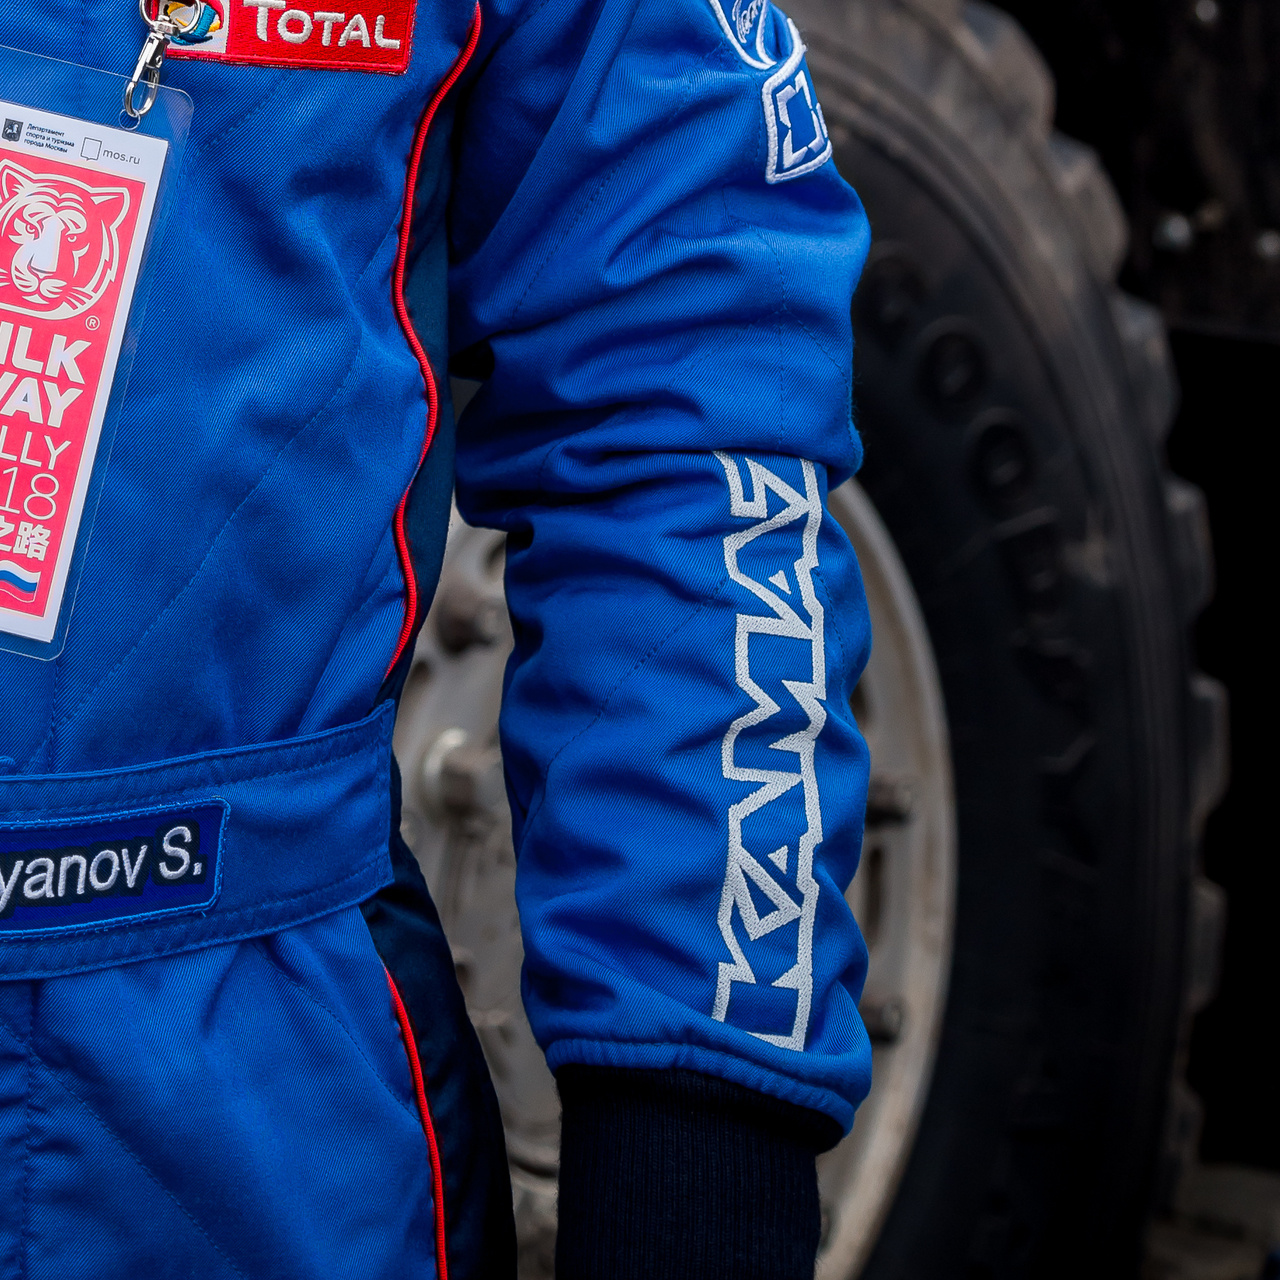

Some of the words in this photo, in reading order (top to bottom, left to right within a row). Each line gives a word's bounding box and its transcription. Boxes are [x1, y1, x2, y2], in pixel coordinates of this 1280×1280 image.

[25, 131, 46, 142] спорта
[27, 123, 65, 137] Департамент
[23, 138, 45, 148] города
[45, 142, 68, 153] Москвы
[102, 148, 141, 165] mos.ru
[158, 824, 203, 880] S.
